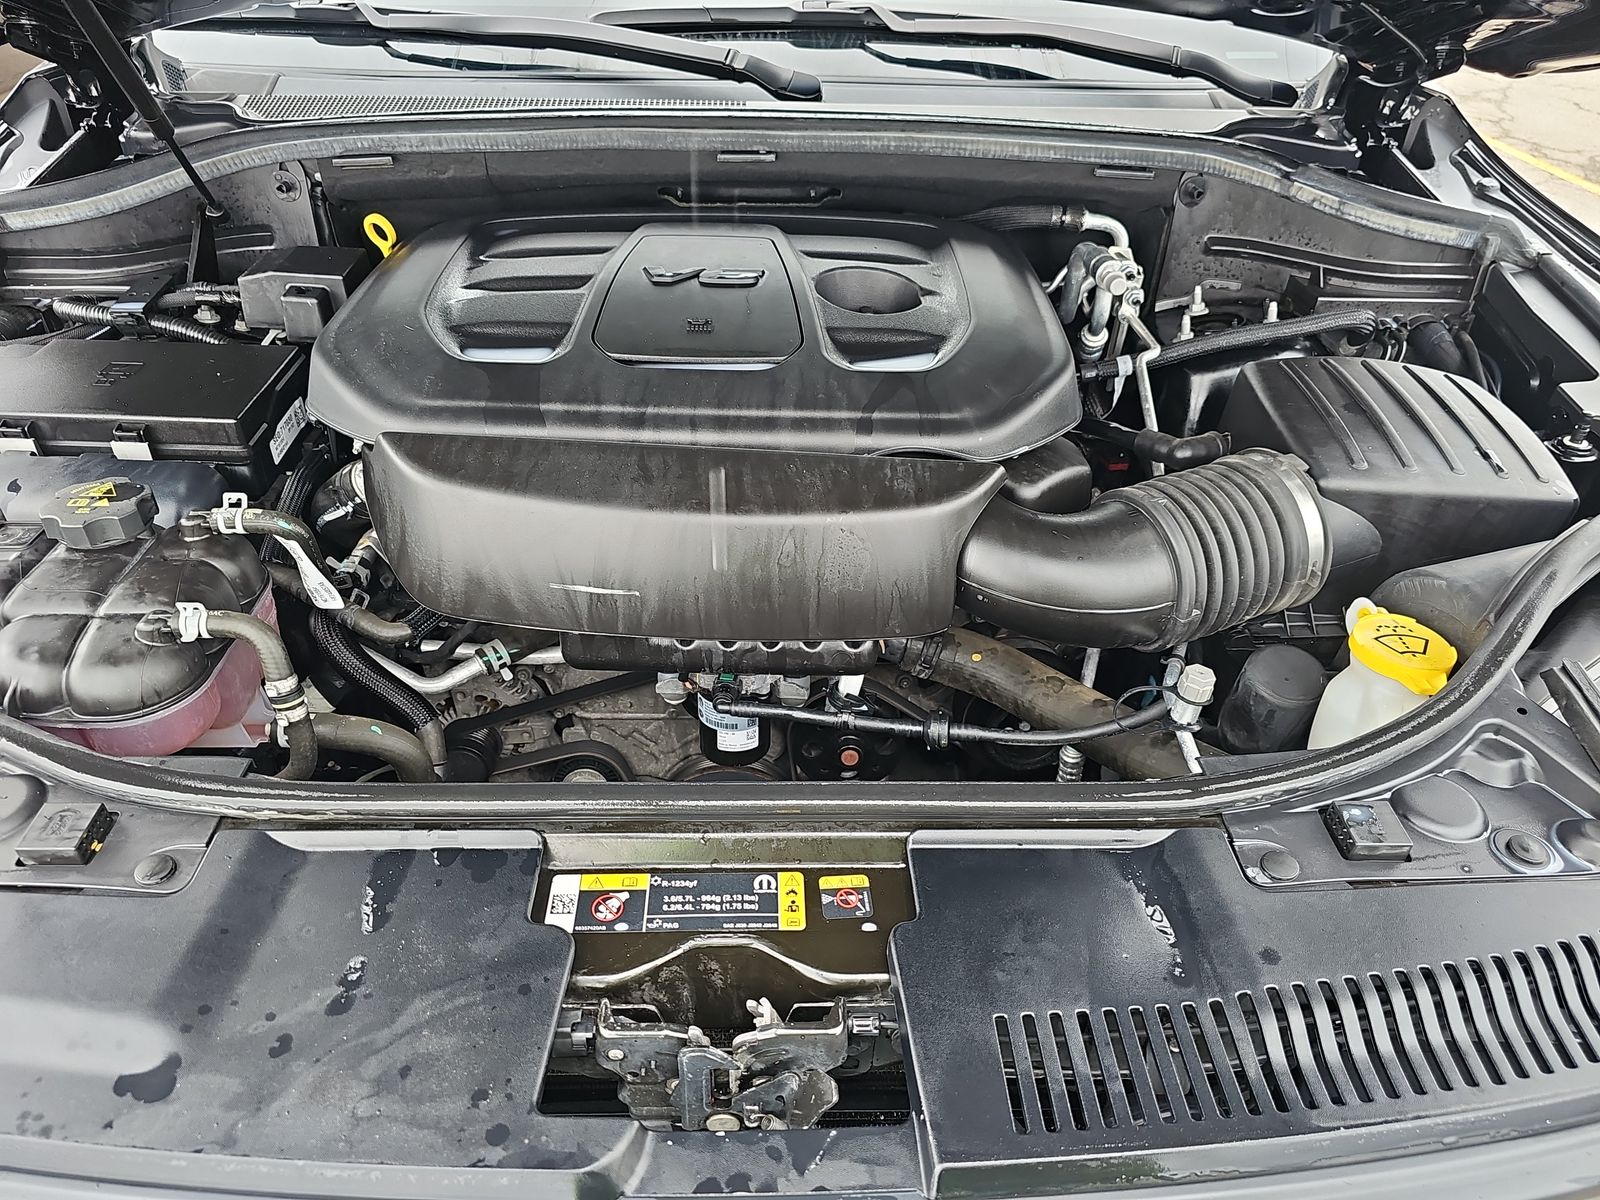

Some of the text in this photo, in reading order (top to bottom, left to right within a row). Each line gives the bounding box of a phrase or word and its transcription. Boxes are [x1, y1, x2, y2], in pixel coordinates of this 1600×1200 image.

[661, 880, 698, 889] R-1234yf
[722, 894, 742, 902] (2.13
[743, 894, 759, 902] lbs)
[743, 903, 759, 911] lbs)
